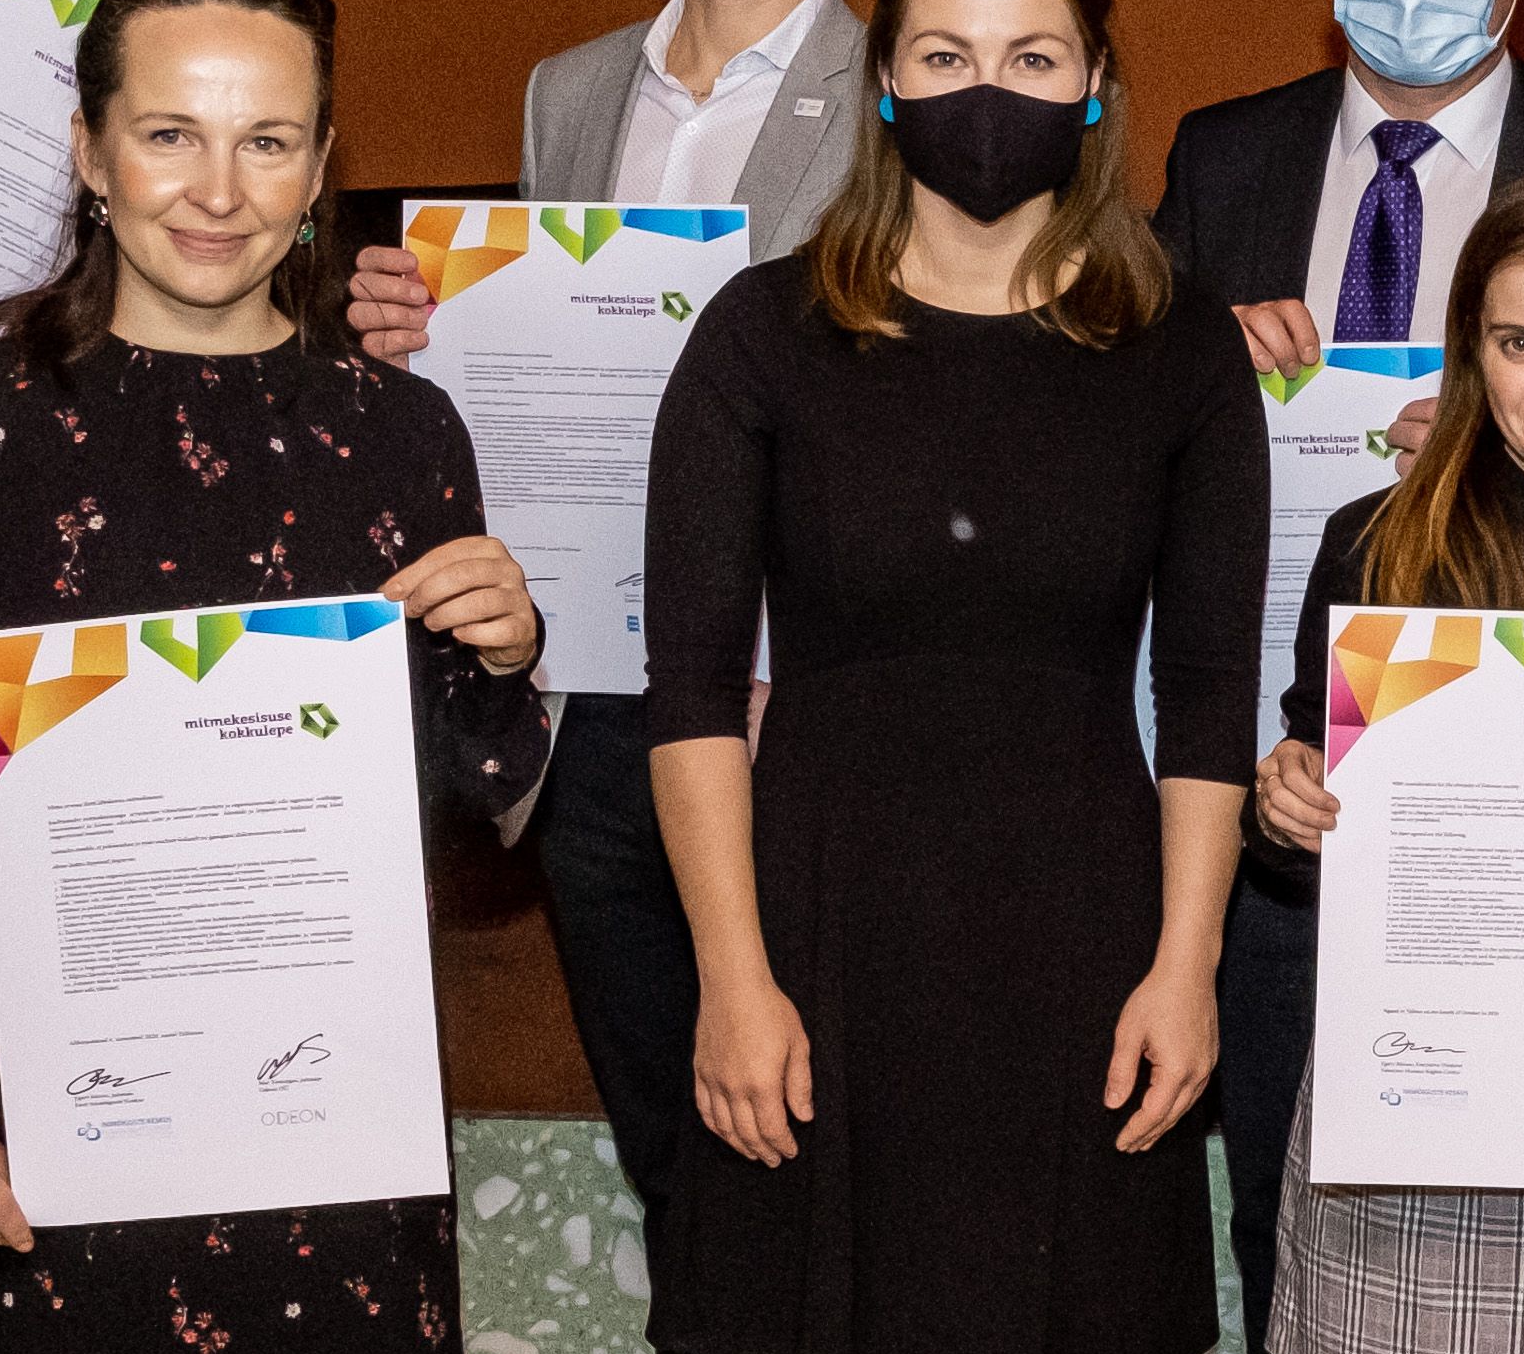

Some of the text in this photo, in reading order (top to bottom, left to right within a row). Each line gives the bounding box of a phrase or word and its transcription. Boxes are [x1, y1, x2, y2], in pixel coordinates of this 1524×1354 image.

[34, 49, 76, 77] mitmek
[570, 295, 656, 305] mitmekesisuse
[597, 306, 656, 318] kokkulepe
[1270, 434, 1360, 444] mitmekesisuse
[1298, 444, 1360, 457] kokkulepe
[184, 711, 293, 730] mitmekesisuse
[219, 725, 294, 740] kokkulepe
[261, 1107, 327, 1127] ODEON
